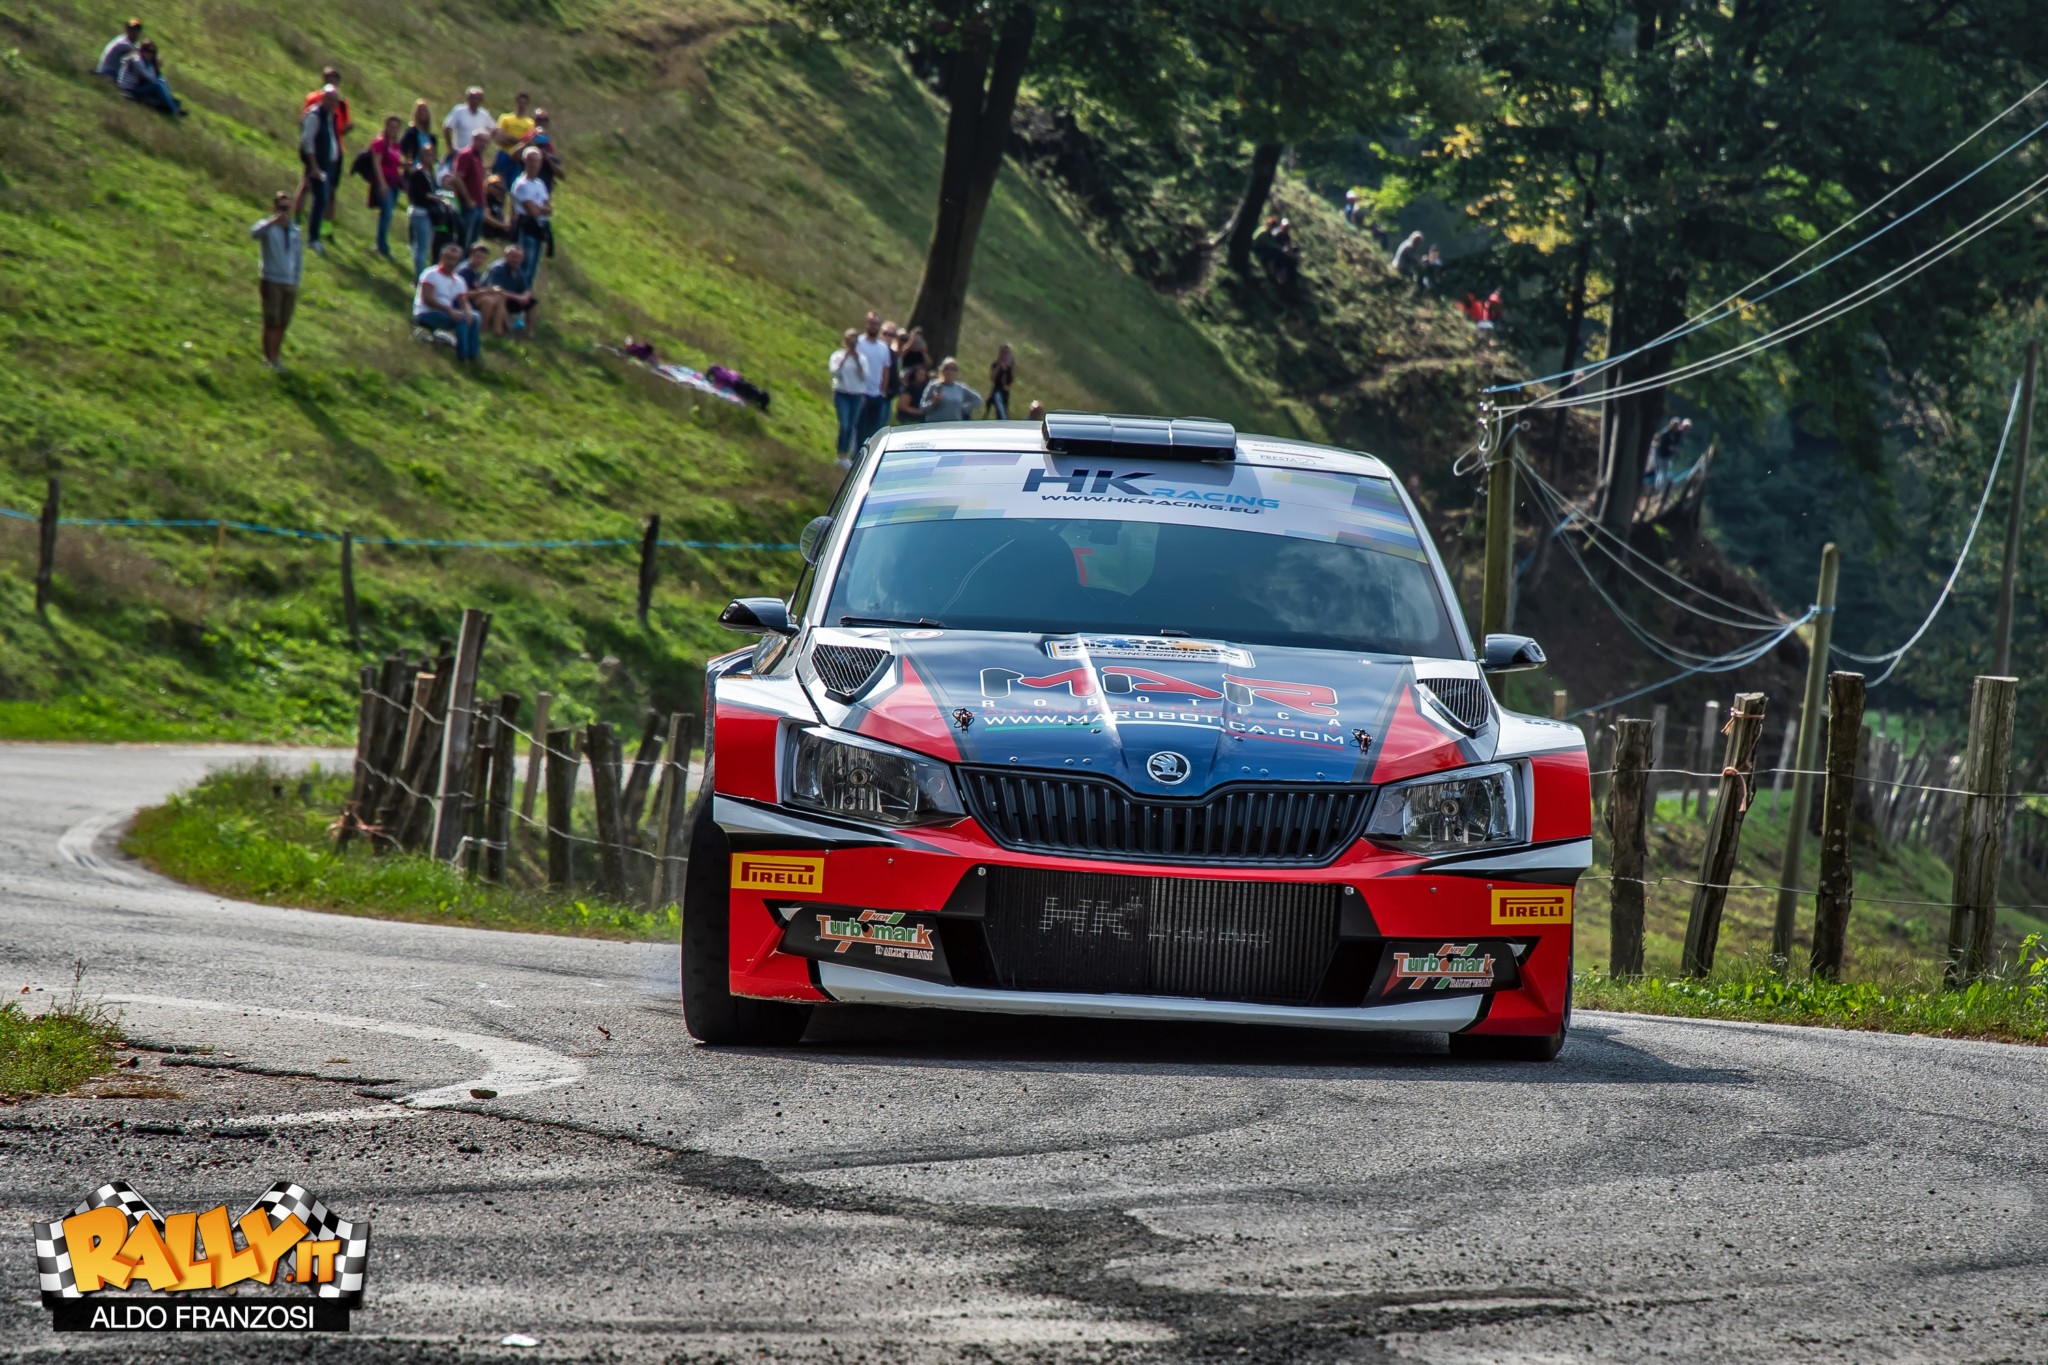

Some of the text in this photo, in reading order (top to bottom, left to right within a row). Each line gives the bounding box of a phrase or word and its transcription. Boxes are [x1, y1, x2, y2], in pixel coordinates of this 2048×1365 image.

[1022, 468, 1280, 509] HK RACING
[1041, 494, 1260, 514] WWW.HKRACING.EU
[1107, 651, 1199, 659] CONCORRENTE
[983, 711, 1345, 745] WWW.MAROBOTICA.COM
[740, 861, 816, 885] PIRELLI
[871, 913, 890, 922] NEW
[1499, 896, 1565, 917] PIRELLI
[816, 914, 934, 949] Turbomark
[906, 949, 934, 961] TEAM
[1394, 953, 1496, 977] Turbomark
